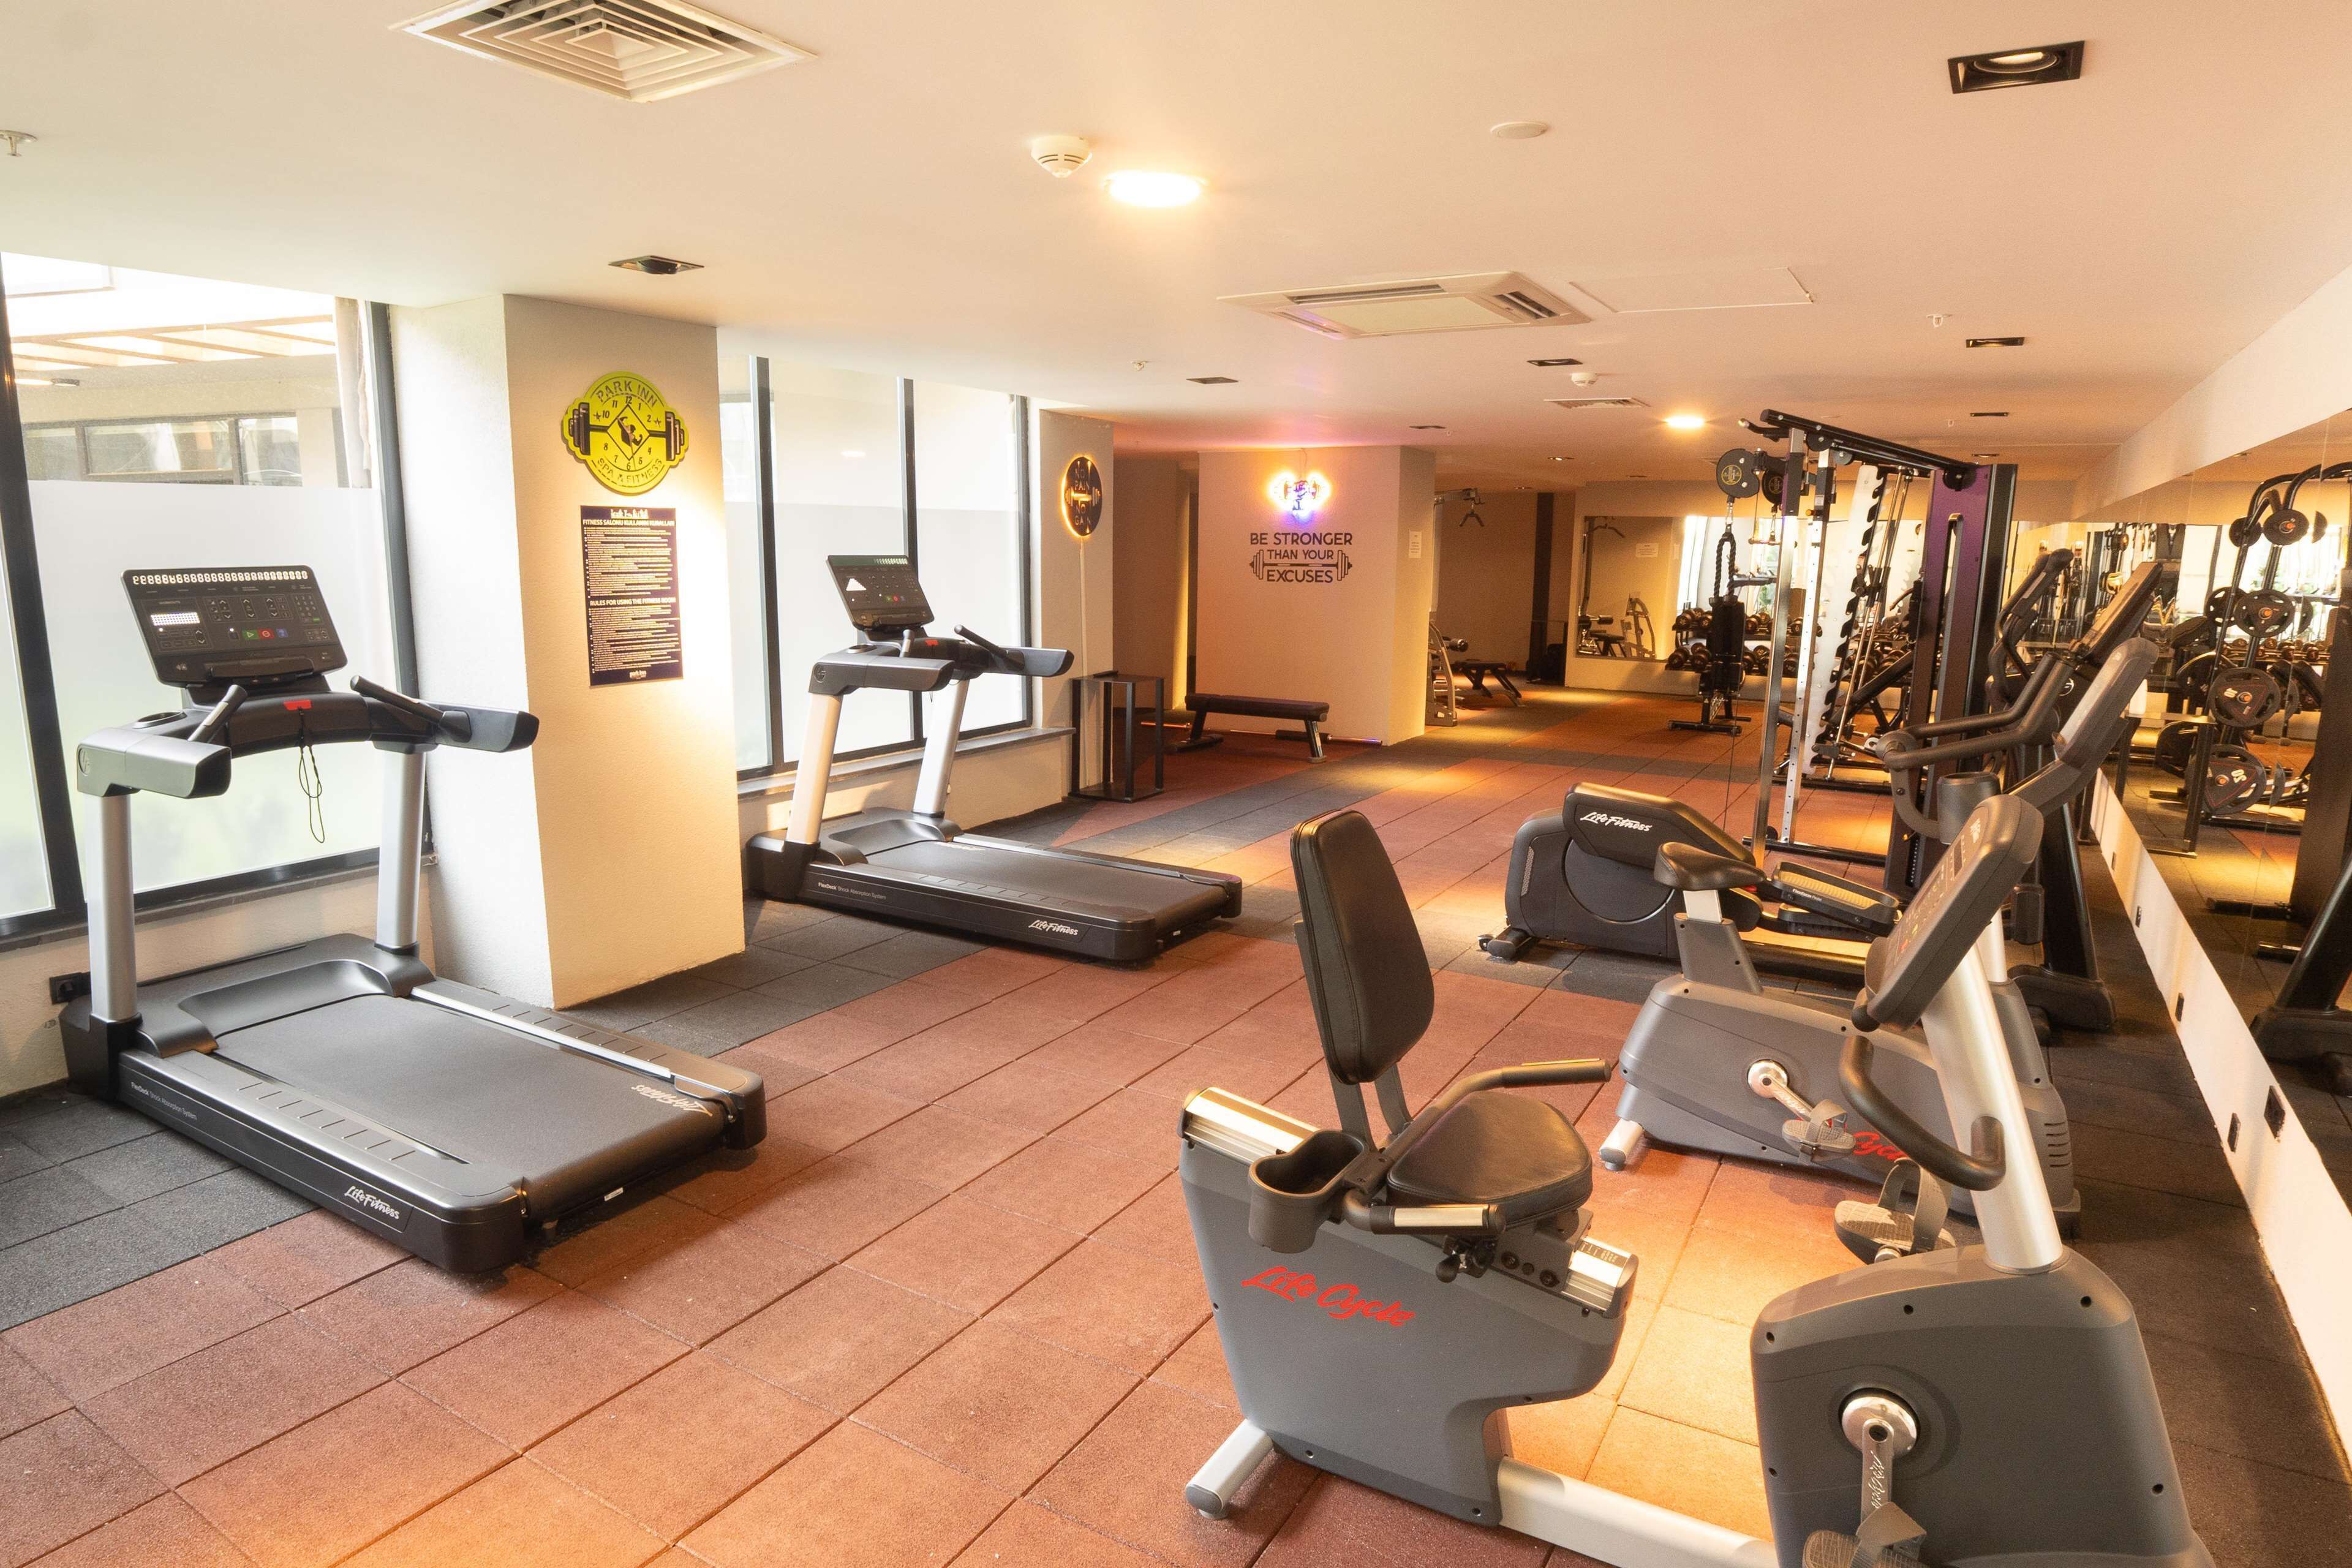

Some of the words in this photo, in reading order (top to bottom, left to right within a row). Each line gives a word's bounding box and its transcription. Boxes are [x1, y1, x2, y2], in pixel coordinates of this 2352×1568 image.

[597, 380, 632, 402] PARK
[637, 385, 657, 407] INN
[597, 458, 614, 478] SPA
[627, 459, 662, 483] FITNESS
[1250, 533, 1268, 545] BE
[1273, 532, 1352, 545] STRONGER
[1267, 549, 1298, 559] THAN
[1302, 550, 1333, 560] YOUR
[1267, 570, 1333, 583] EXCUSES
[1241, 1266, 1318, 1302] Life
[1316, 1283, 1415, 1327] Cycle
